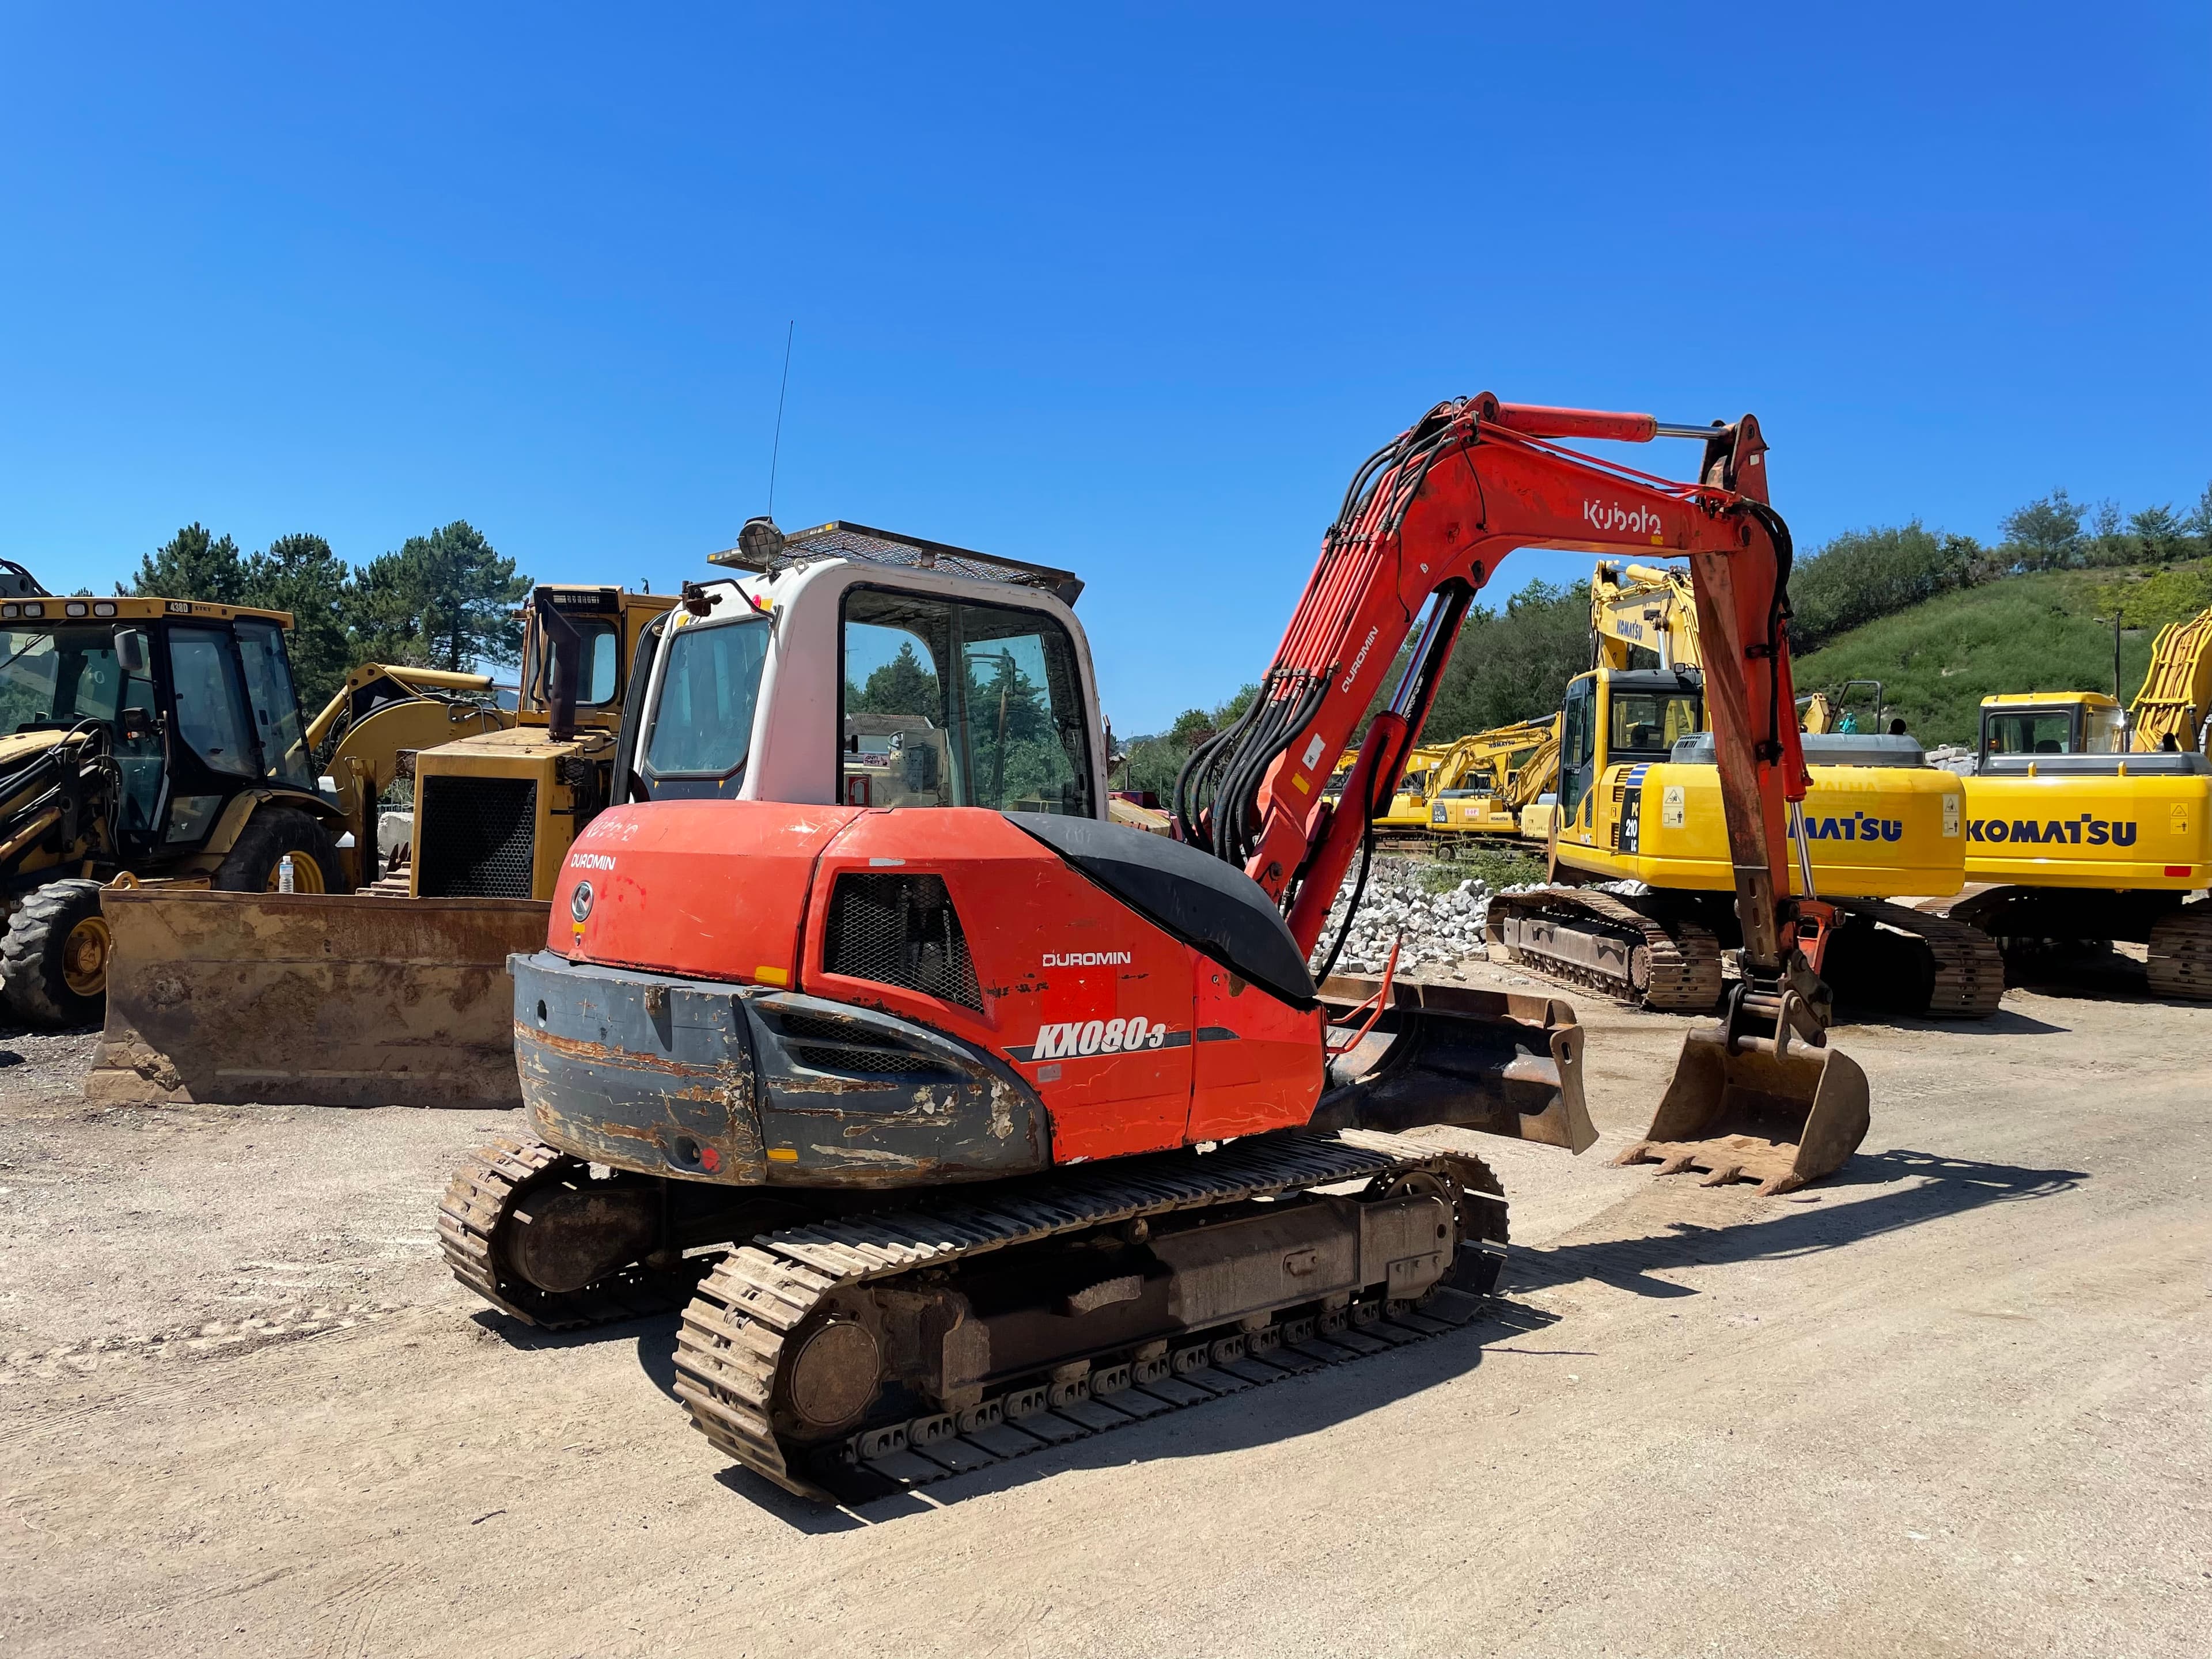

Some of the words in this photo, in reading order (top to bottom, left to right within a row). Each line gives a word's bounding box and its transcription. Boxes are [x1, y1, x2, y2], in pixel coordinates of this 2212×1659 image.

[1584, 498, 1661, 535] Kubota
[170, 602, 188, 613] 438D
[1616, 619, 1643, 641] KOMATSU
[1342, 626, 1379, 694] DUROMIN
[1488, 740, 1515, 749] KOMATSU
[1631, 802, 1639, 817] PC
[1625, 819, 1638, 838] 210
[1786, 811, 1903, 842] MATSU
[1966, 813, 2137, 847] KOMATSU
[1631, 839, 1638, 852] LC
[570, 853, 616, 870] DUROMIN
[1043, 952, 1131, 967] DUROMIN
[1032, 1016, 1166, 1059] KX080-3
